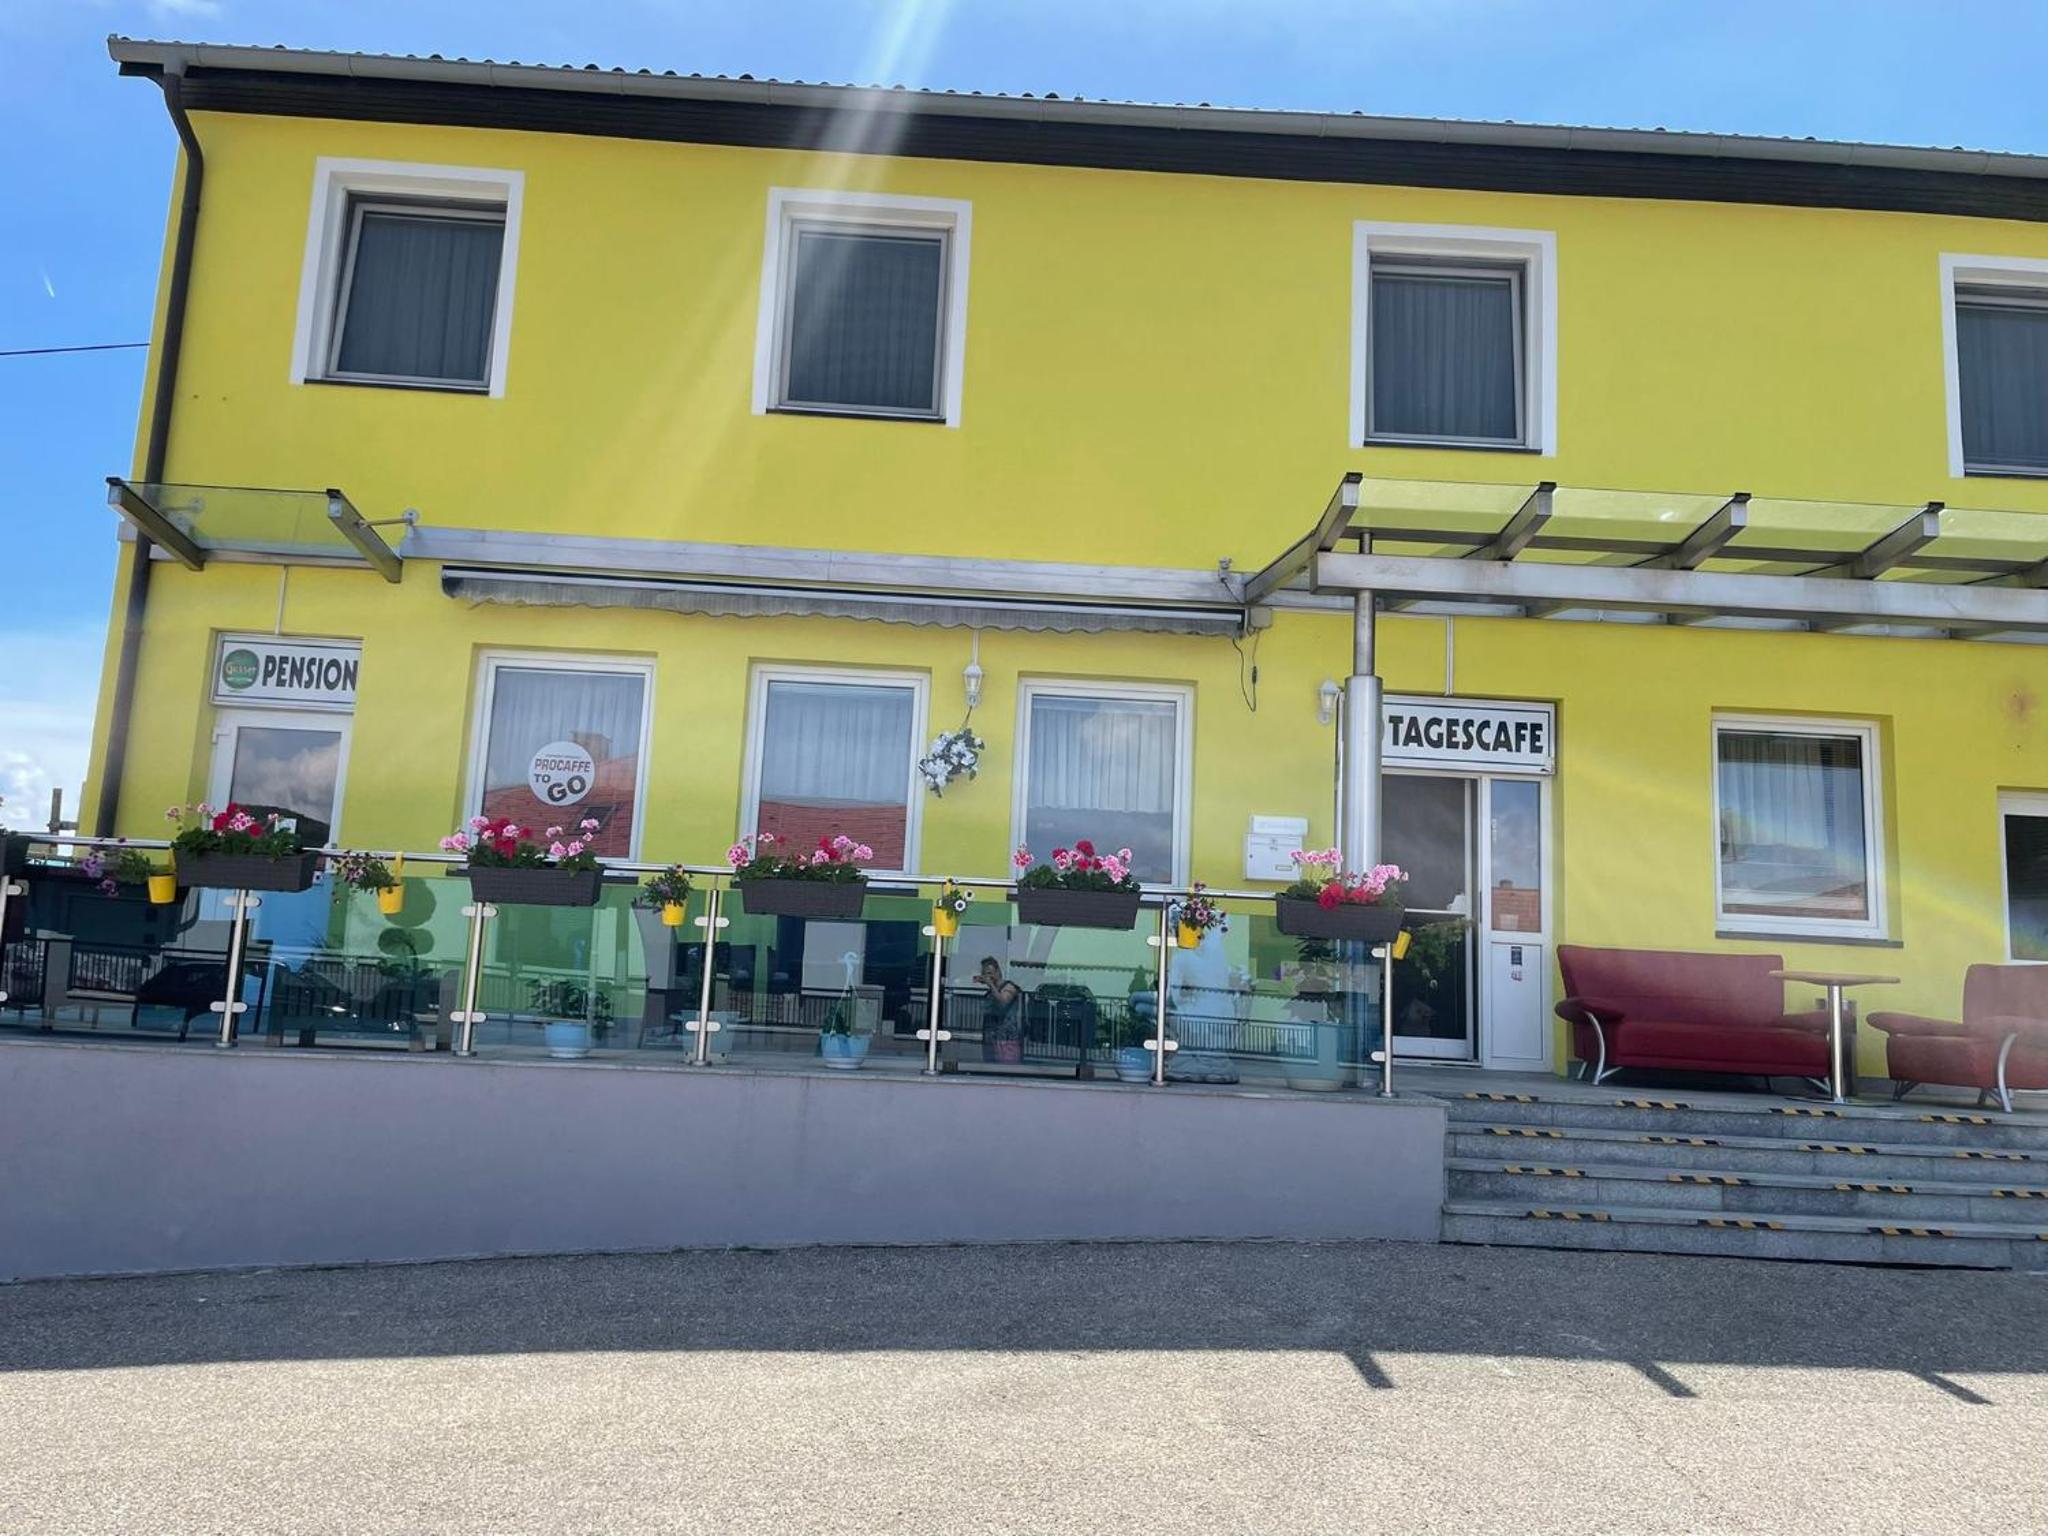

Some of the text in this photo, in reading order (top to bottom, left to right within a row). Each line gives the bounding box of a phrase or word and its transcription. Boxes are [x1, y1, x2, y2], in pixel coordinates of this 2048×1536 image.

[262, 655, 358, 691] PENSION
[1388, 715, 1544, 754] TAGESCAFE
[534, 758, 591, 773] PROCAFFE
[534, 773, 587, 802] TO GO
